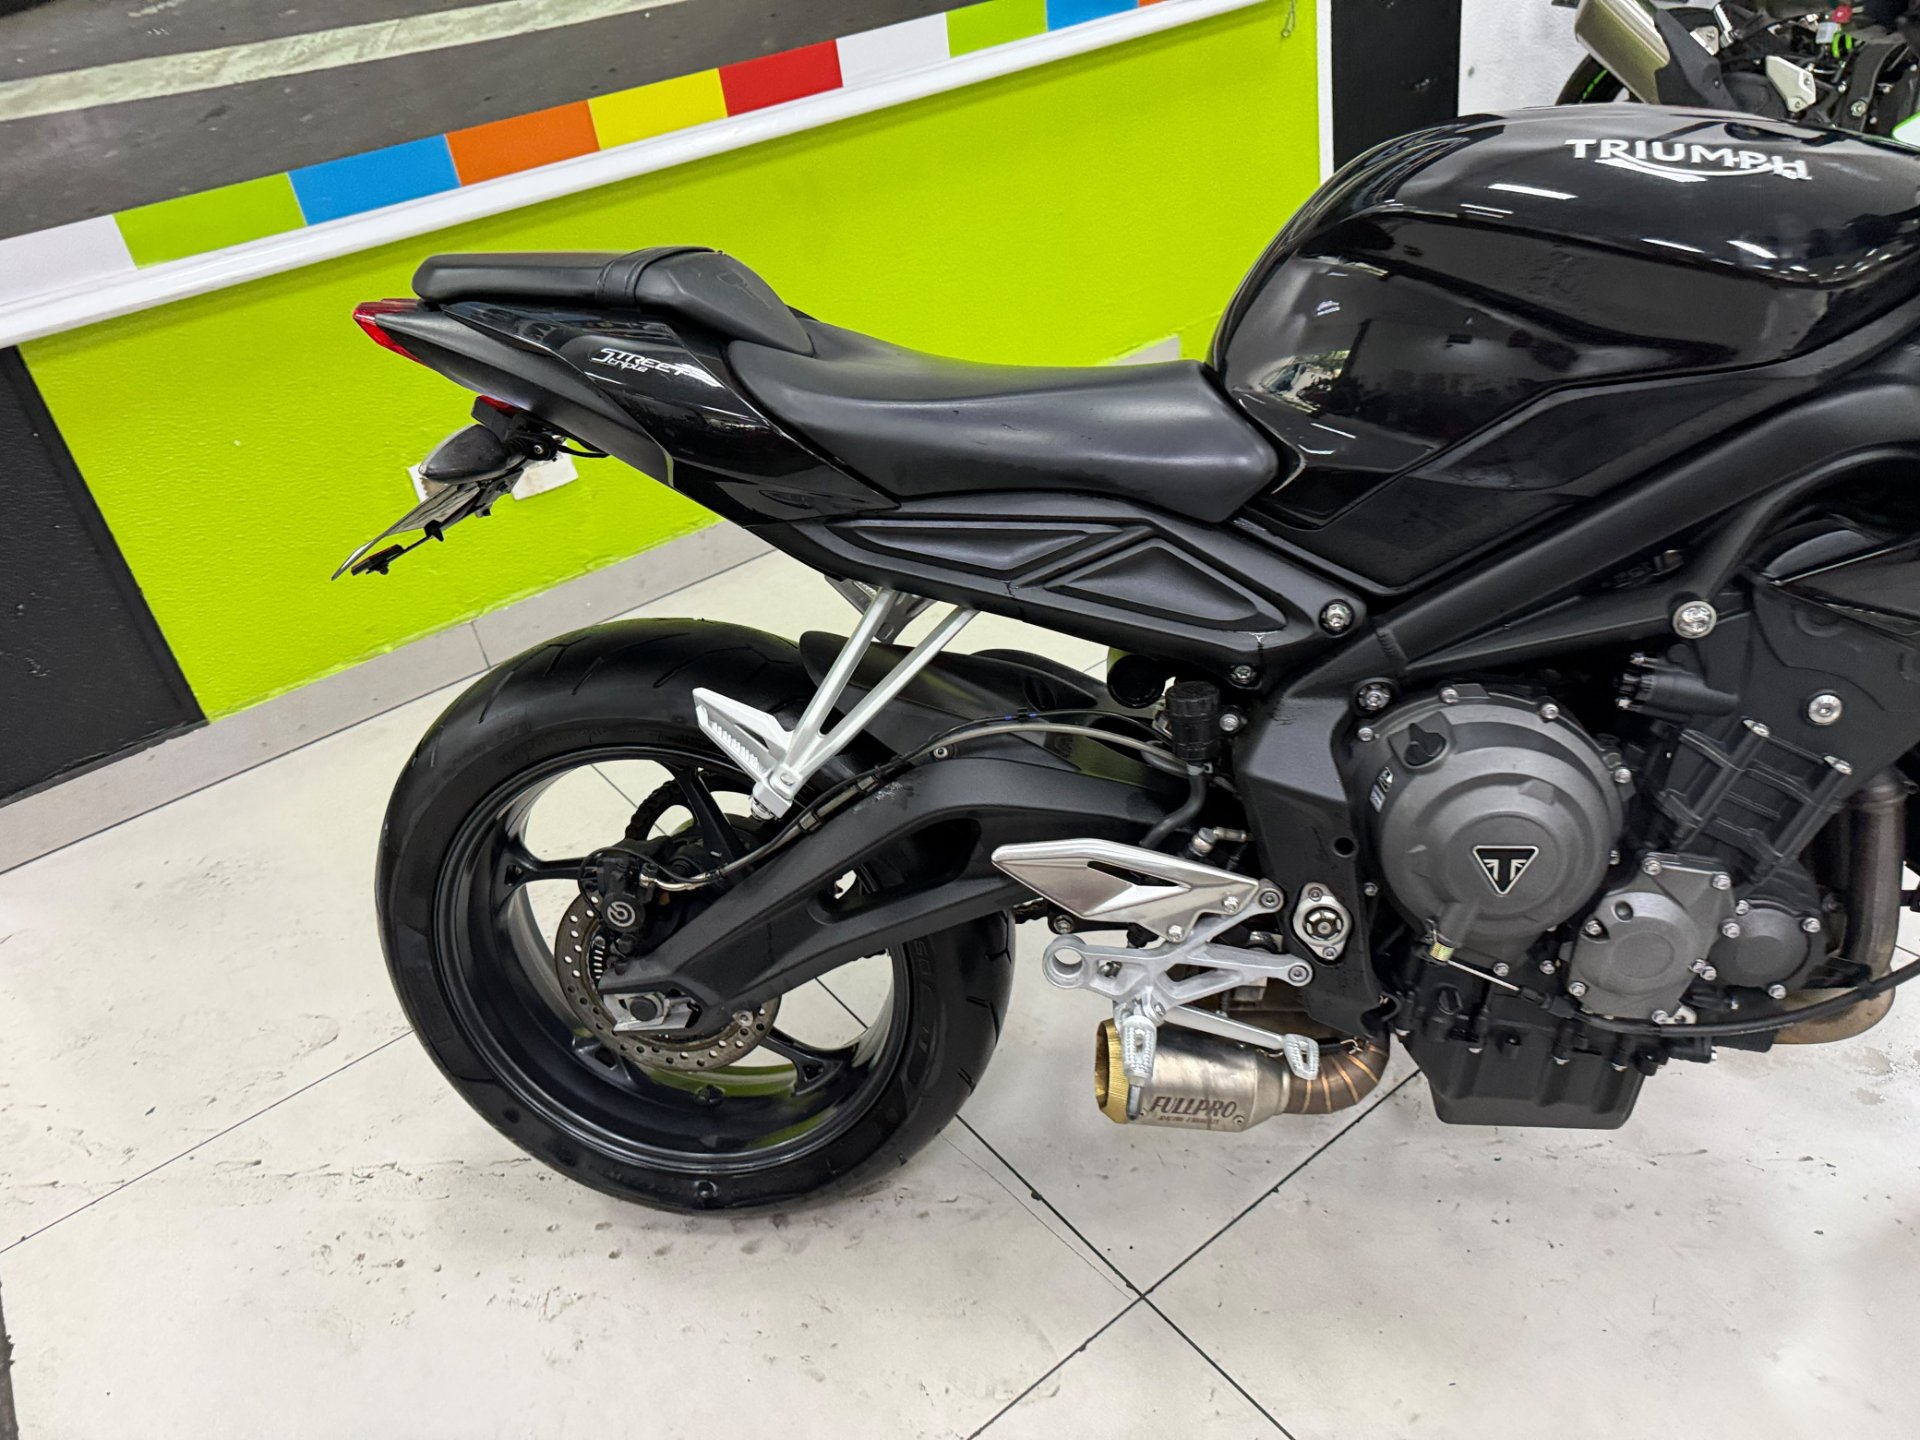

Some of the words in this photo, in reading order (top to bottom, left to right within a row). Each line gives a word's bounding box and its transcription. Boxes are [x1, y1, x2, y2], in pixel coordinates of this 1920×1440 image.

[1564, 138, 1812, 181] TRIUMPH
[591, 347, 692, 376] STREET
[1149, 1095, 1237, 1118] FULLPRO
